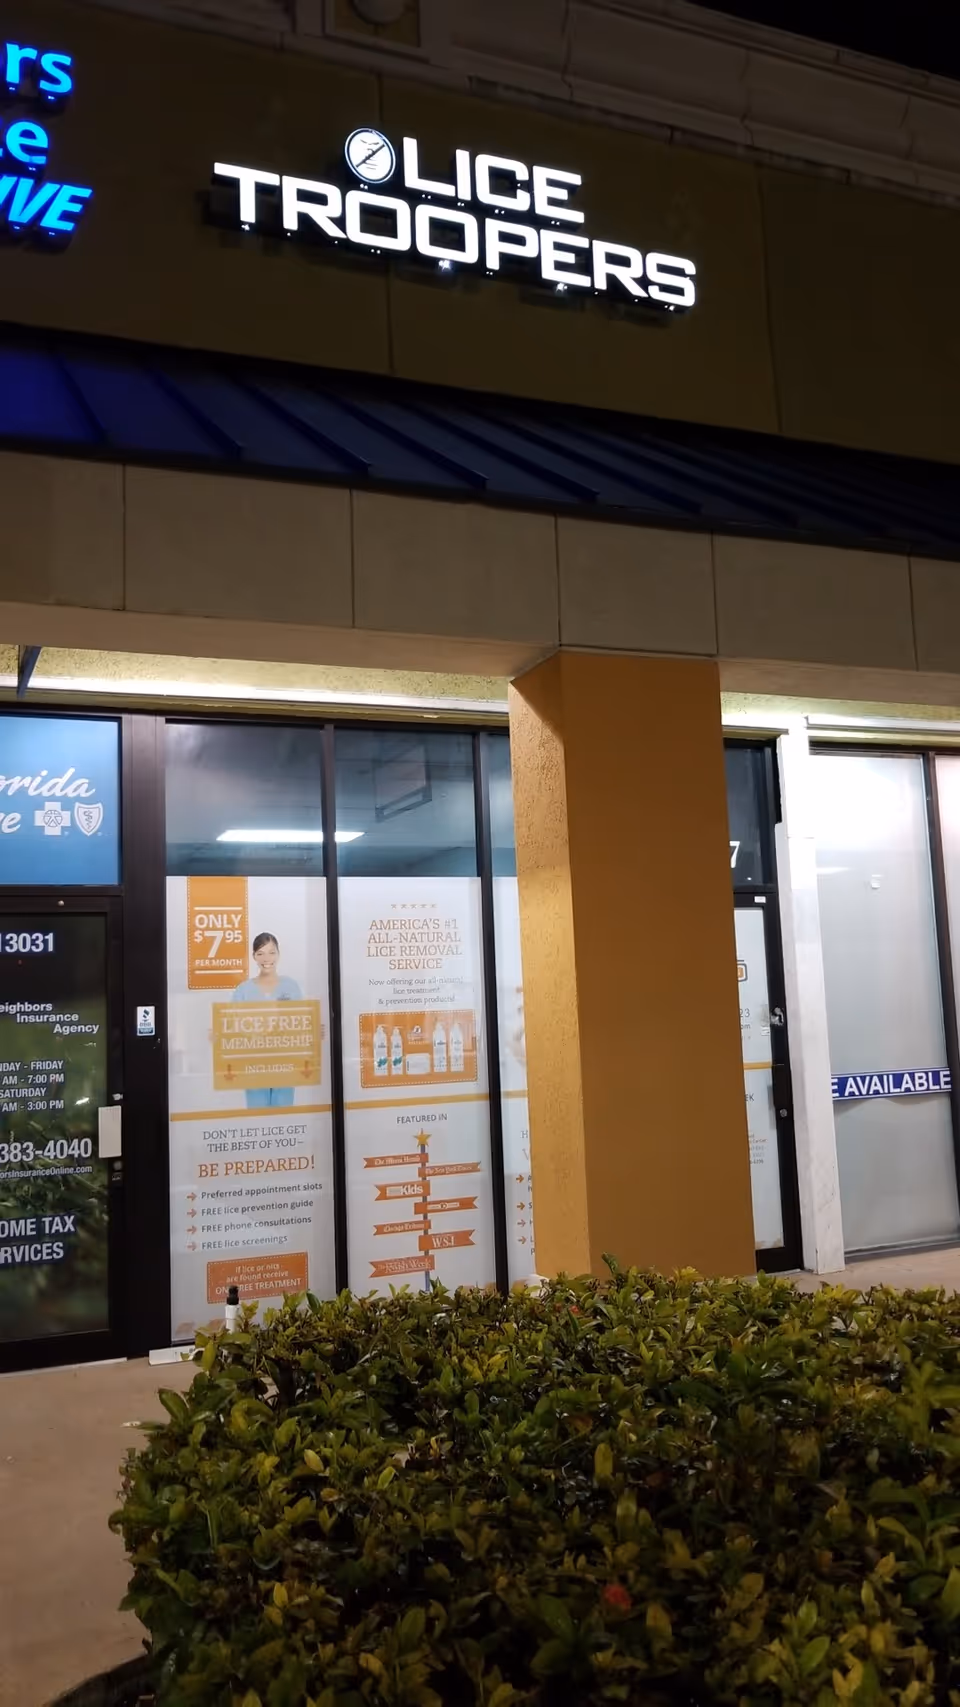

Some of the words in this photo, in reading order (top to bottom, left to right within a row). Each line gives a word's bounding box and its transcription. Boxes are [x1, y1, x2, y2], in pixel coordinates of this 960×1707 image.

[402, 136, 585, 223] LICE
[213, 161, 697, 307] TROOPERS
[195, 913, 242, 928] ONLY
[369, 918, 440, 931] AMERICA'S
[444, 918, 458, 929] #1
[368, 931, 461, 944] ALL-NATURAL
[367, 946, 396, 957] LICE
[399, 944, 463, 956] REMOVAL
[195, 959, 210, 967] PER
[212, 958, 242, 967] MONTH
[388, 958, 443, 970] SERVICE
[386, 977, 413, 987] offering
[385, 998, 422, 1007] prevention
[16, 1013, 79, 1023] Insurance
[222, 1016, 264, 1034] LICE
[267, 1015, 312, 1032] FREE
[53, 1023, 99, 1035] Agency
[221, 1035, 313, 1050] MEMBERSHIP
[31, 1060, 64, 1070] FRIDAY
[245, 1063, 294, 1074] INCLUDES
[2, 1075, 17, 1085] AM
[27, 1074, 47, 1084] 7:00
[50, 1073, 64, 1083] PM
[844, 1070, 952, 1097] AVAILABLE
[0, 1087, 47, 1098] SATURDAY
[2, 1102, 17, 1112] AM
[27, 1101, 47, 1110] 3:00
[50, 1100, 64, 1109] PM
[396, 1114, 437, 1124] FEATURED
[438, 1113, 448, 1122] IN
[203, 1129, 238, 1140] DON'T
[240, 1127, 259, 1138] LET
[261, 1126, 285, 1137] LICE
[287, 1124, 307, 1135] GET
[207, 1142, 229, 1153] THE
[231, 1141, 257, 1151] BEST
[259, 1139, 272, 1149] OF
[198, 1163, 219, 1178] BE
[224, 1154, 316, 1176] PREPARED!
[201, 1188, 243, 1200] Preferred
[245, 1183, 301, 1198] appointment
[303, 1182, 323, 1192] slots
[400, 1184, 423, 1195] Kids
[201, 1207, 222, 1216] FREE
[224, 1205, 239, 1214] lice
[241, 1201, 289, 1215] prevention
[290, 1199, 314, 1211] guide
[41, 1214, 75, 1234] TAX
[201, 1223, 222, 1233] FREE
[224, 1221, 252, 1234] phone
[254, 1216, 312, 1229] consultations
[201, 1241, 222, 1250] FREE
[224, 1238, 240, 1247] lice
[242, 1234, 288, 1247] screenings
[242, 1264, 255, 1273] lice
[240, 1272, 261, 1282] found
[262, 1270, 289, 1279] receive
[215, 1285, 229, 1295] ON
[239, 1283, 253, 1292] REE
[255, 1277, 302, 1290] TREATMENT
